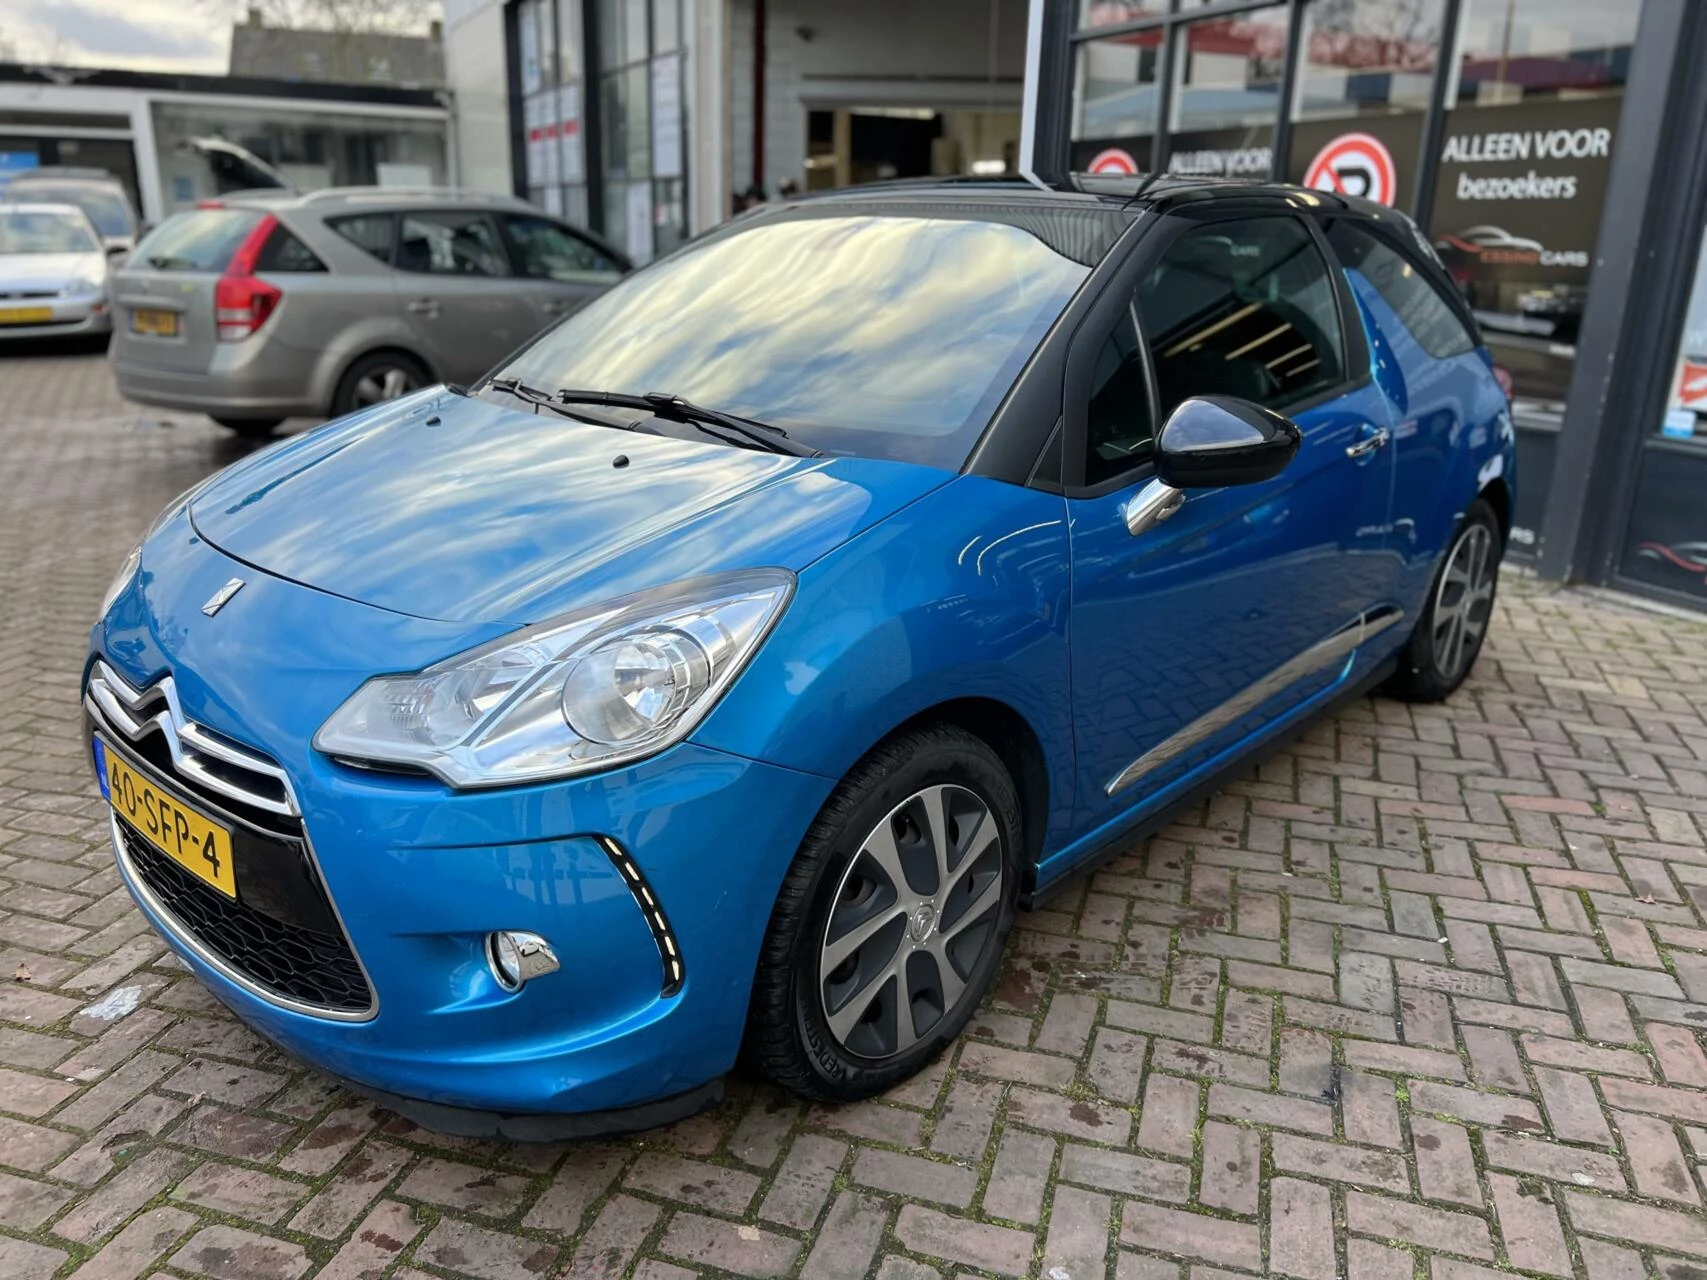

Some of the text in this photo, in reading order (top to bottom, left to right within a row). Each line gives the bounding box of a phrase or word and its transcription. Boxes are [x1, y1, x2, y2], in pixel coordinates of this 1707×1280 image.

[1441, 127, 1611, 163] ALLEEN VOOR
[1456, 170, 1577, 200] bezoekers
[111, 762, 221, 879] 40-SFP-4
